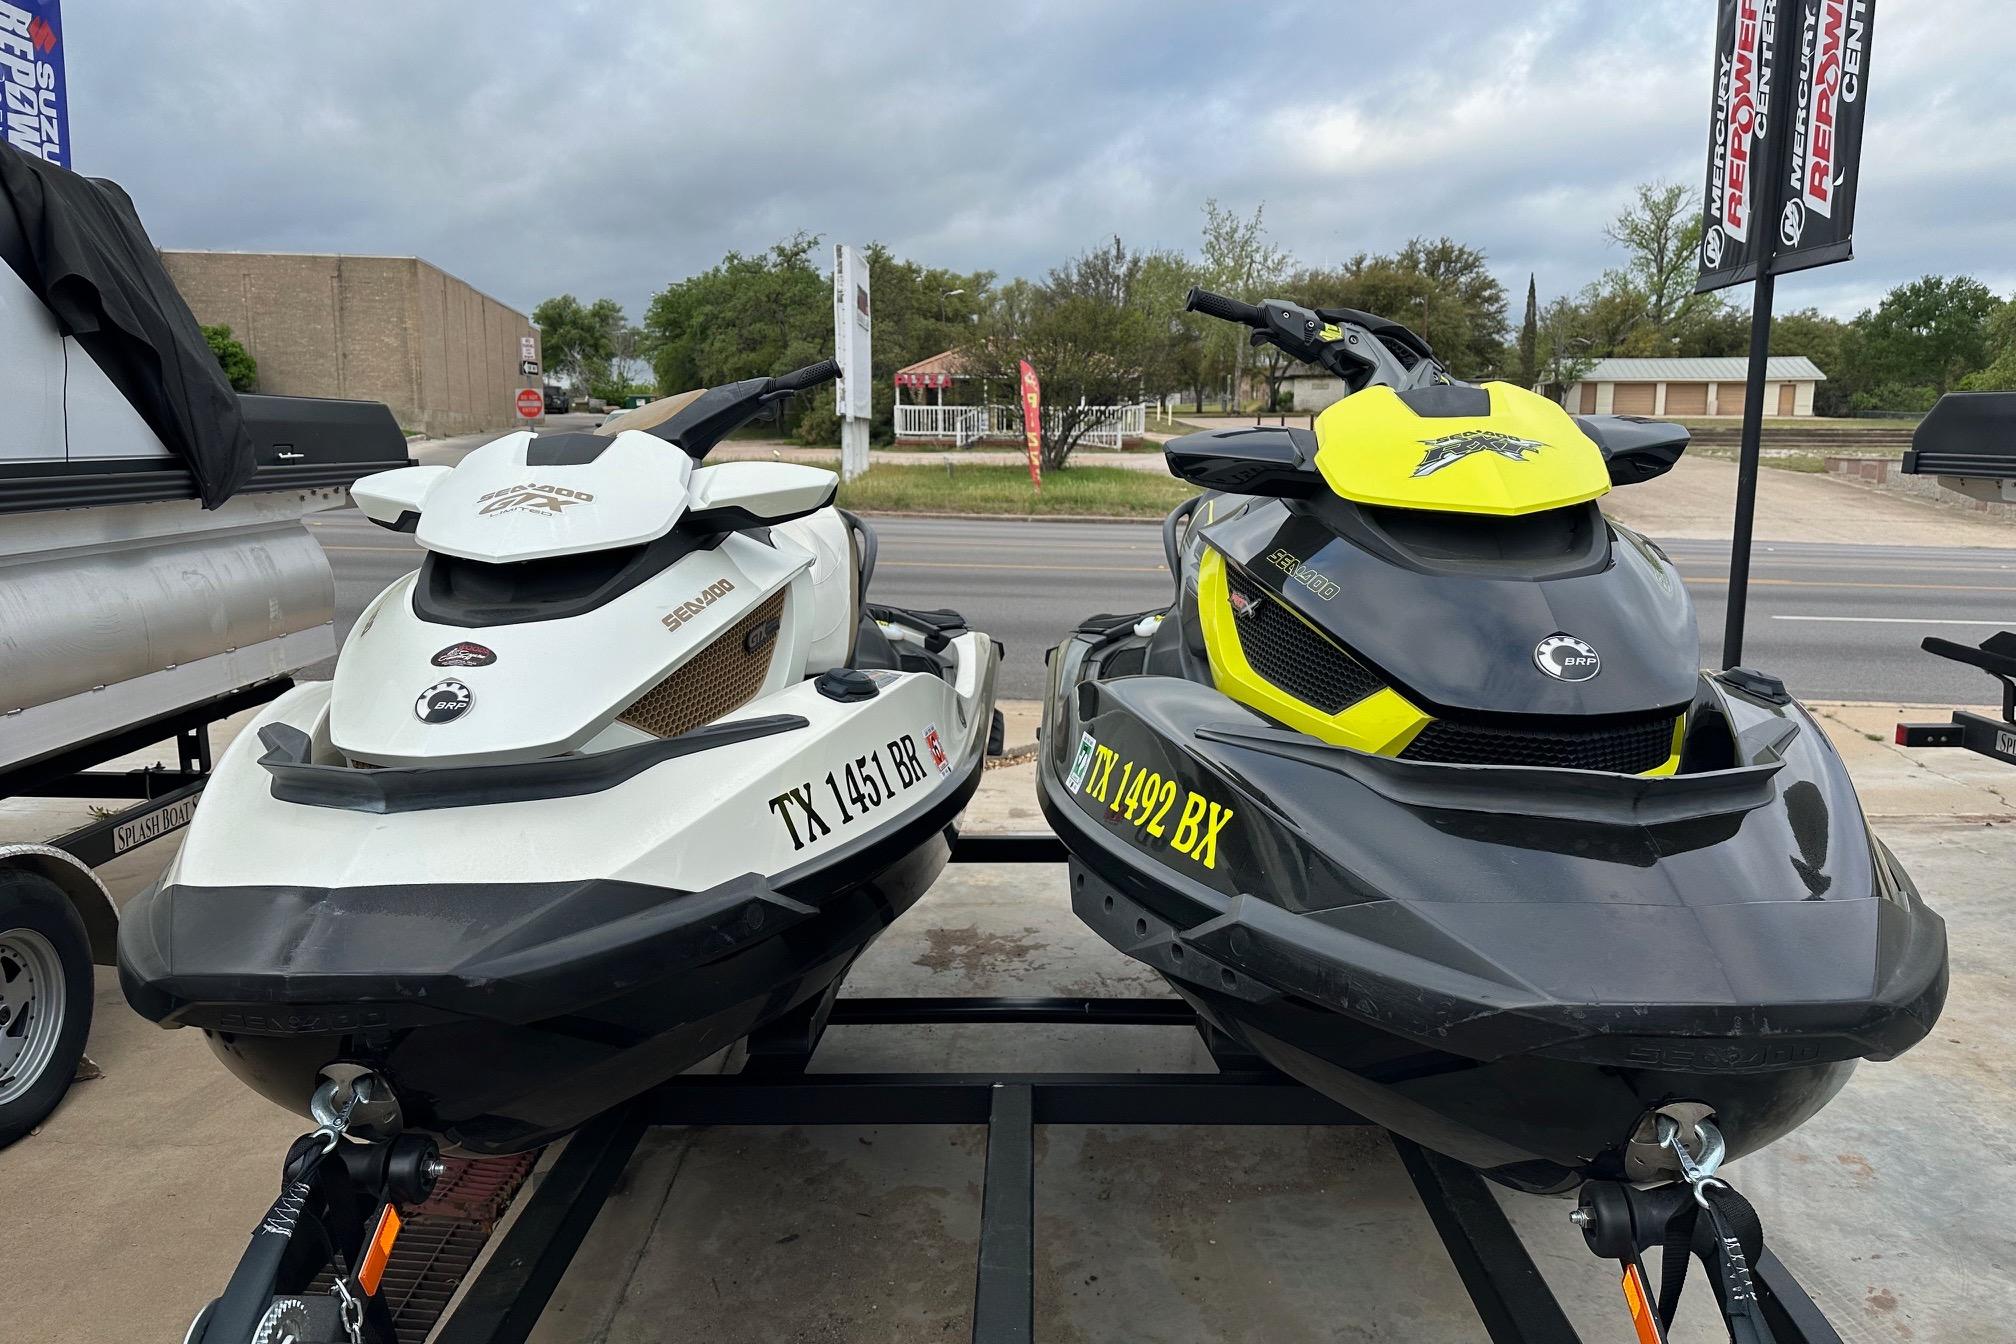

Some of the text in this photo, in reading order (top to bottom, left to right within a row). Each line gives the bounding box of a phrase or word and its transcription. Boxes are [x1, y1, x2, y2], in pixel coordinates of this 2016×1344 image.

[1790, 3, 1816, 190] MERCURY
[1808, 0, 1844, 202] REPOW
[1711, 52, 1731, 218] MERCURY
[895, 373, 952, 388] PIZZA
[479, 492, 580, 515] GTX
[489, 506, 553, 518] LIMITED
[1564, 657, 1597, 666] BRP
[434, 701, 467, 710] BRP
[768, 782, 831, 851] TX
[825, 750, 895, 825] 1451
[887, 734, 927, 790] BR
[1085, 744, 1120, 802] TX
[1110, 761, 1177, 838] 1492
[1170, 791, 1234, 870] BX
